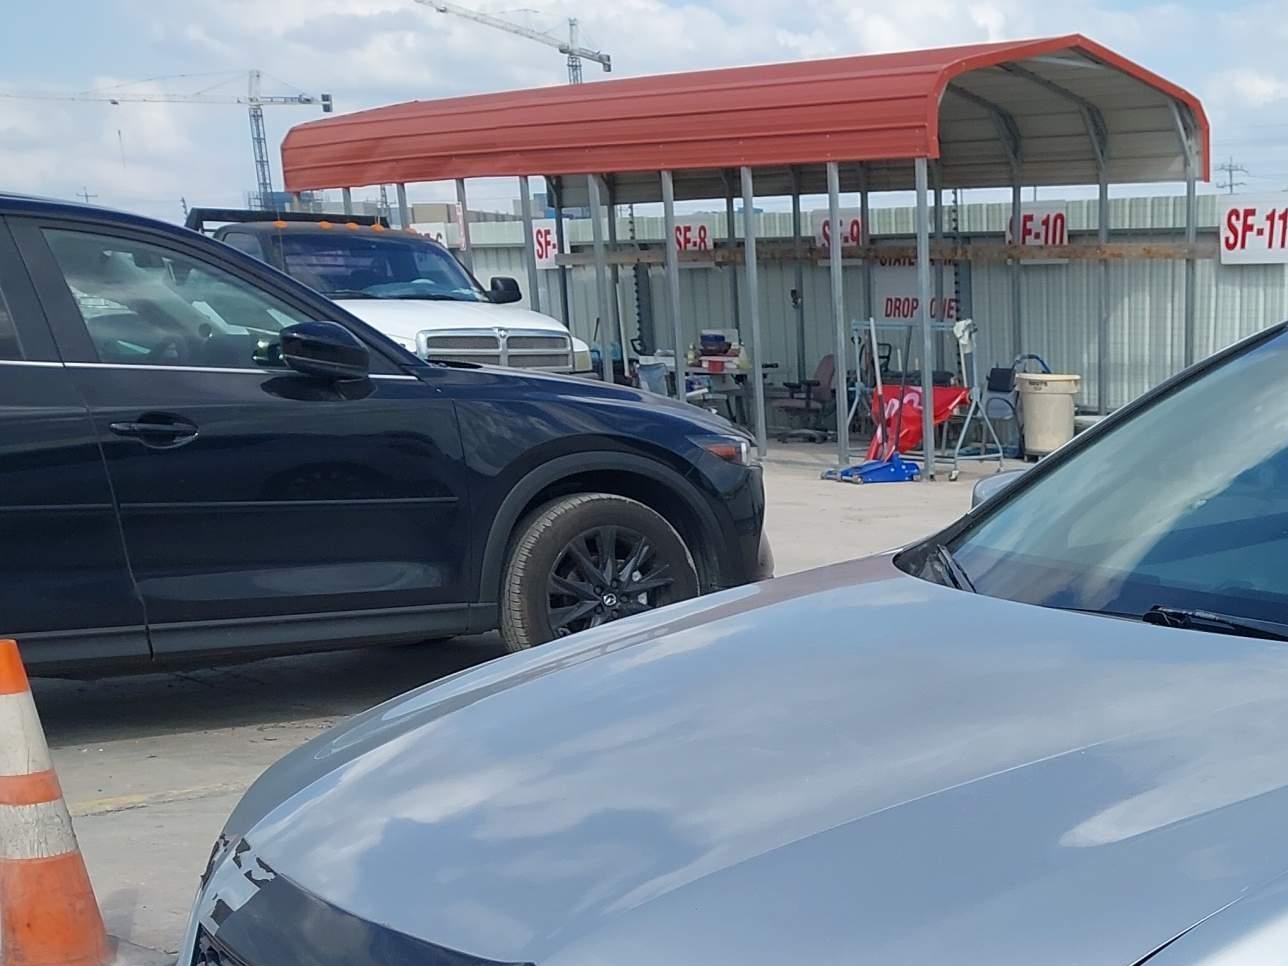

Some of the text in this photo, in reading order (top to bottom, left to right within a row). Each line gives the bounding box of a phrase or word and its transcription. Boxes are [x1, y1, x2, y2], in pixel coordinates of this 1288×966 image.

[535, 228, 557, 260] SF-
[1008, 212, 1066, 246] F-10
[885, 297, 919, 319] DROP
